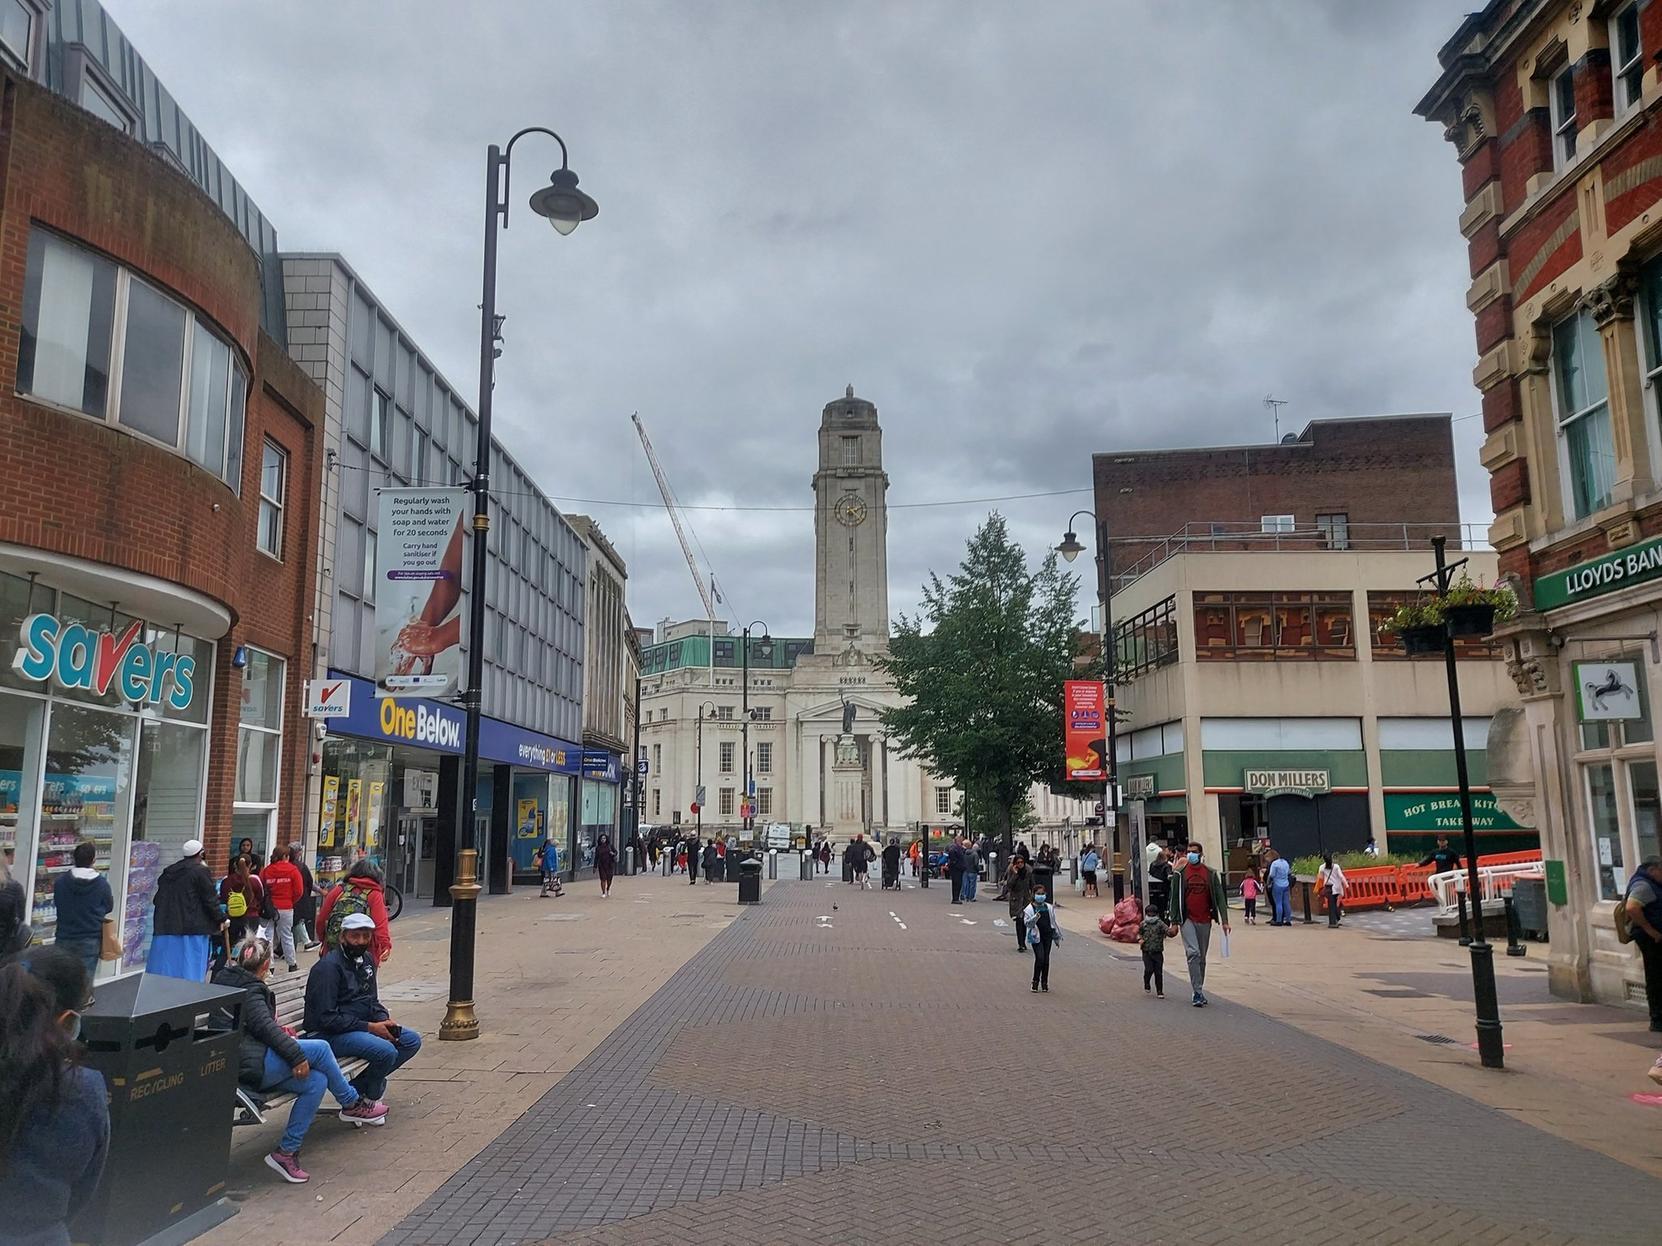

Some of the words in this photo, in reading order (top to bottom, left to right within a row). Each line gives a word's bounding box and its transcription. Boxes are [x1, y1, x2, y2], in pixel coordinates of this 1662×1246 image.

[393, 497, 429, 505] Regularly
[1566, 558, 1624, 595] LLOYDS
[16, 613, 196, 710] savers
[313, 704, 344, 712] savers
[519, 744, 545, 766] everything
[1250, 773, 1276, 786] DON
[1278, 773, 1326, 786] MILLERS
[1403, 804, 1426, 818] HOT
[1430, 799, 1461, 810] BREA
[1435, 817, 1494, 826] TAKEWAY
[200, 1057, 226, 1077] LITTER
[130, 1072, 185, 1101] RECYCLING
